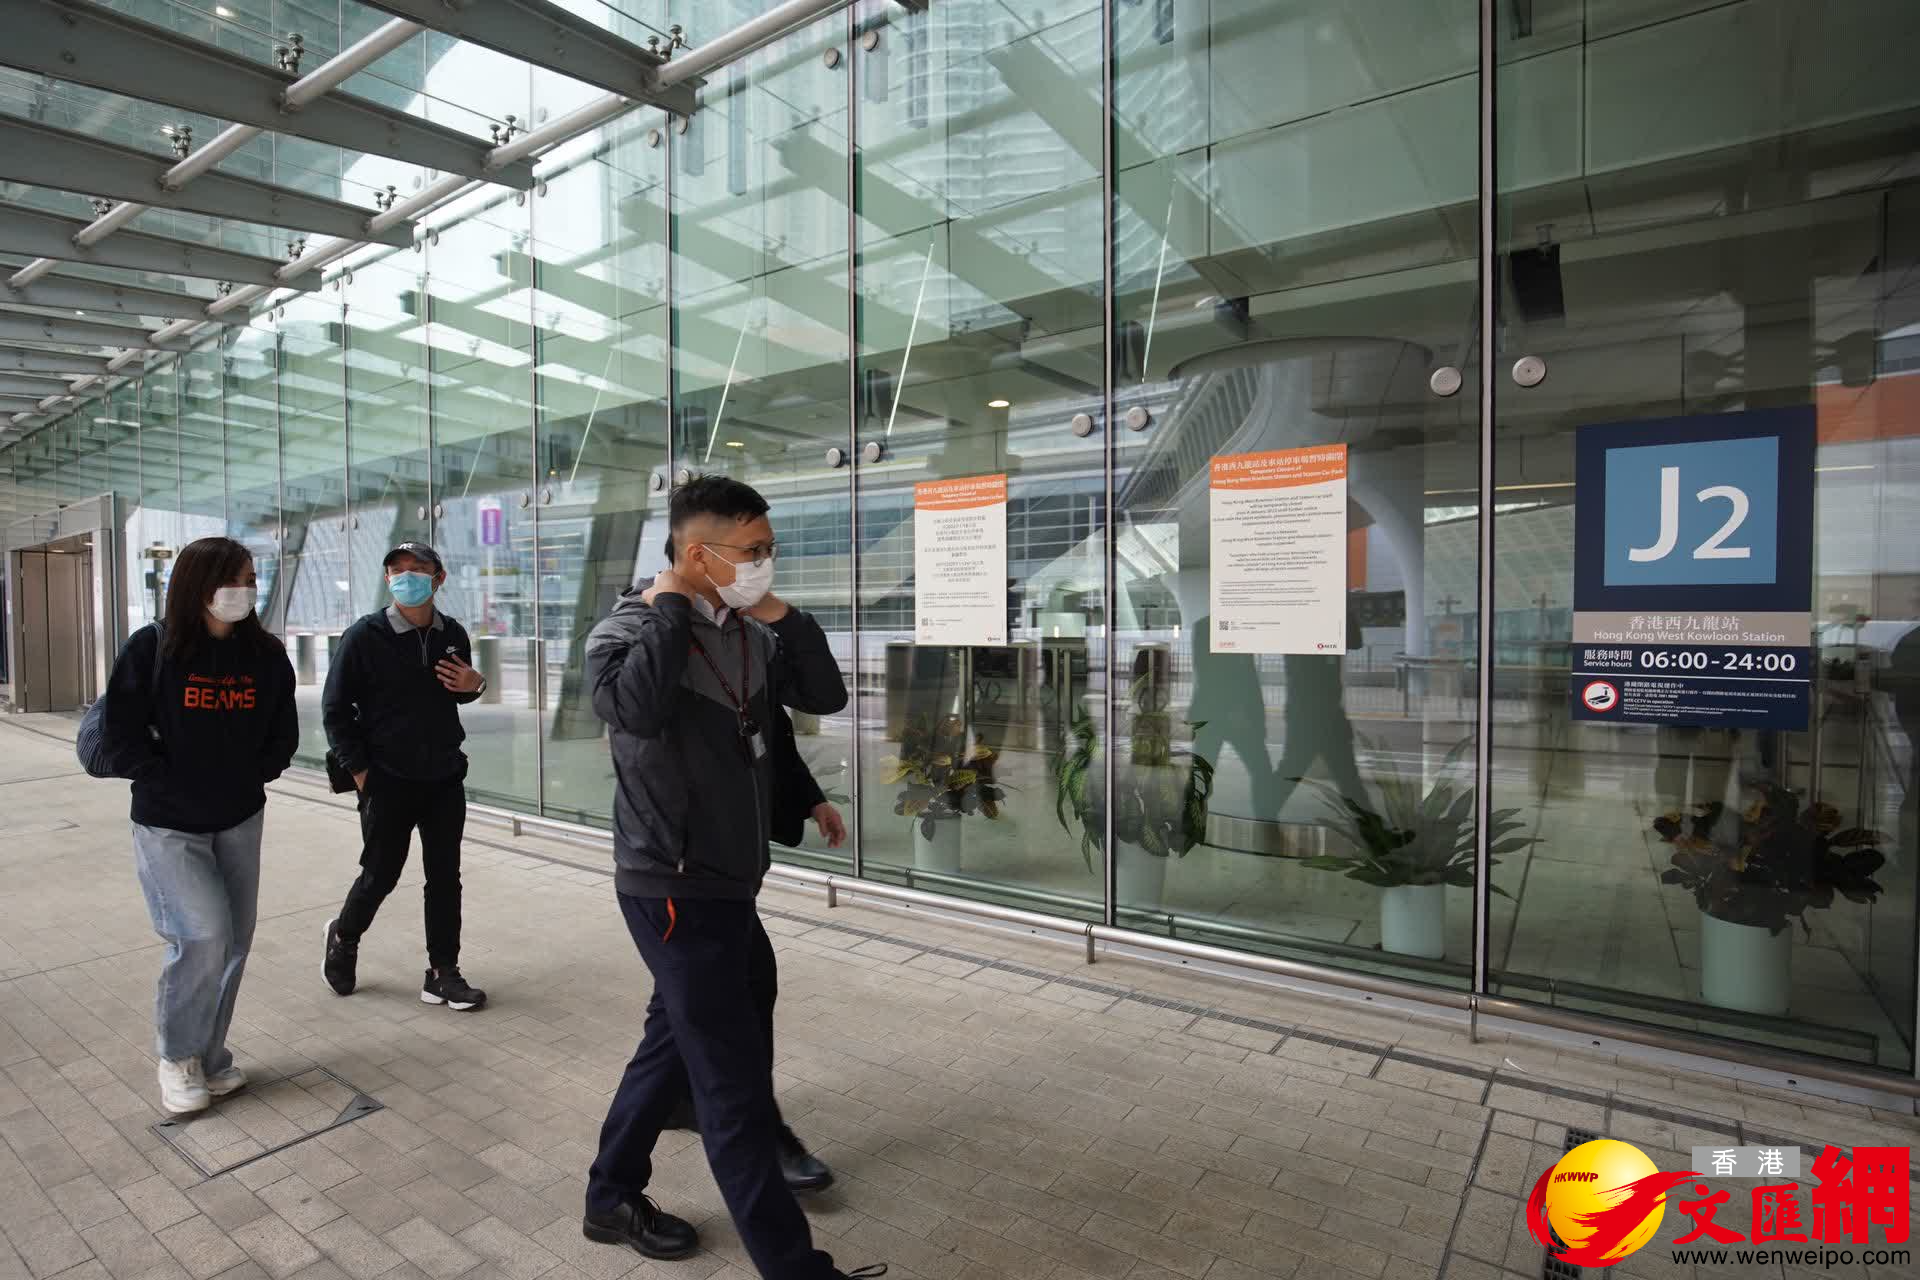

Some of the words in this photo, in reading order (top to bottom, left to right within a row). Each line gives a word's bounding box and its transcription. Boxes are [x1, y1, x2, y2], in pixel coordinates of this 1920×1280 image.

[1628, 467, 1751, 562] J2
[1629, 616, 1741, 631] 香港西九龍站
[1594, 631, 1623, 641] Hong
[1626, 631, 1654, 641] Kong
[1657, 632, 1684, 641] West
[1687, 631, 1739, 641] Kowloon
[1742, 632, 1785, 642] Station
[1584, 649, 1632, 660] 服務時間
[1584, 659, 1609, 667] Service
[1611, 660, 1632, 668] hours
[184, 687, 256, 709] BEAMS
